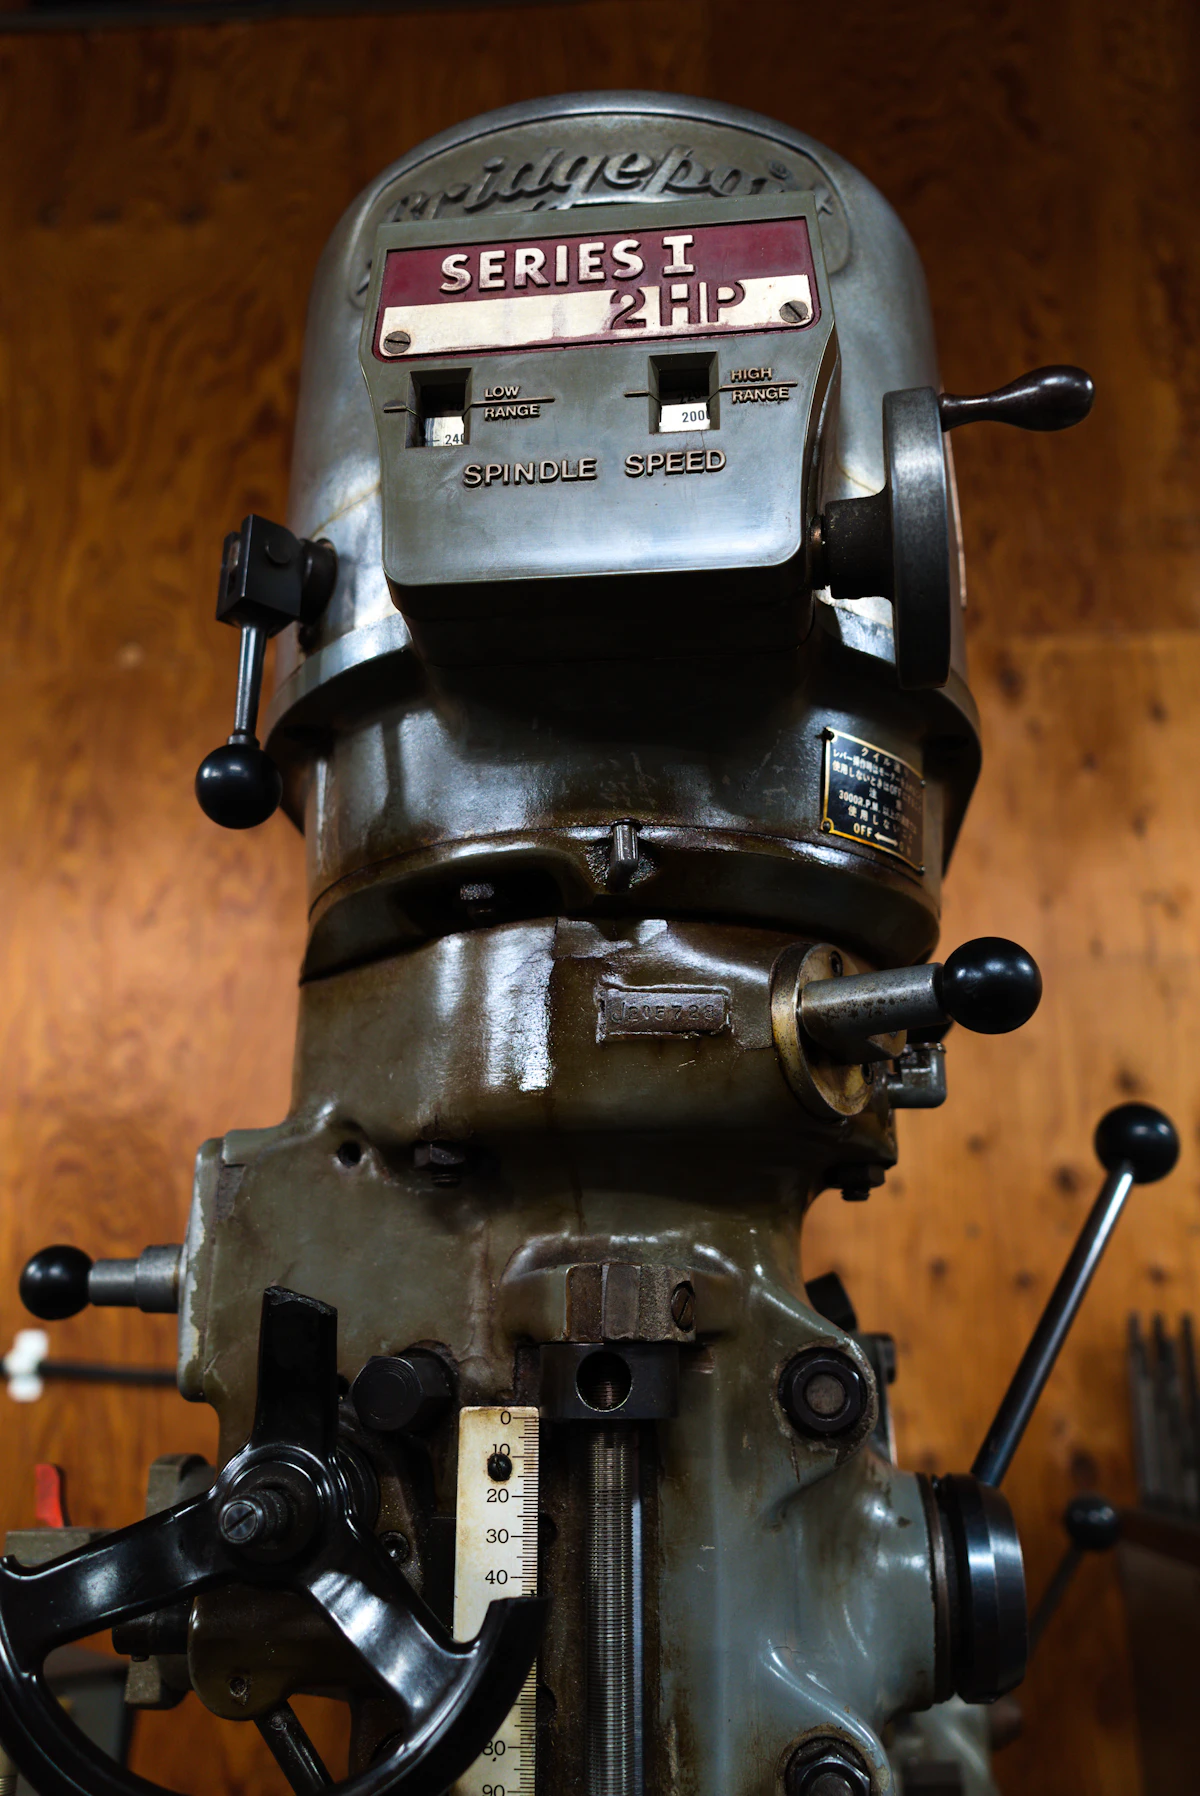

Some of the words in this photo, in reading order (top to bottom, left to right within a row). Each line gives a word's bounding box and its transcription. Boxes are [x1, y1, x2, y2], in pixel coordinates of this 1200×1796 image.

[439, 239, 645, 295] SERIES
[662, 234, 695, 278] I
[610, 279, 747, 332] 2HP
[730, 367, 774, 382] HIGH
[484, 385, 521, 400] LOW
[731, 386, 790, 404] RANGE
[483, 403, 541, 421] RANGE
[462, 457, 598, 489] SPINDLE
[624, 448, 727, 479] SPEED
[853, 822, 873, 838] OFF
[500, 1411, 512, 1425] 0
[486, 1488, 510, 1503] 20
[485, 1528, 510, 1543] 30
[485, 1570, 508, 1584] 40
[482, 1784, 505, 1796] 90
